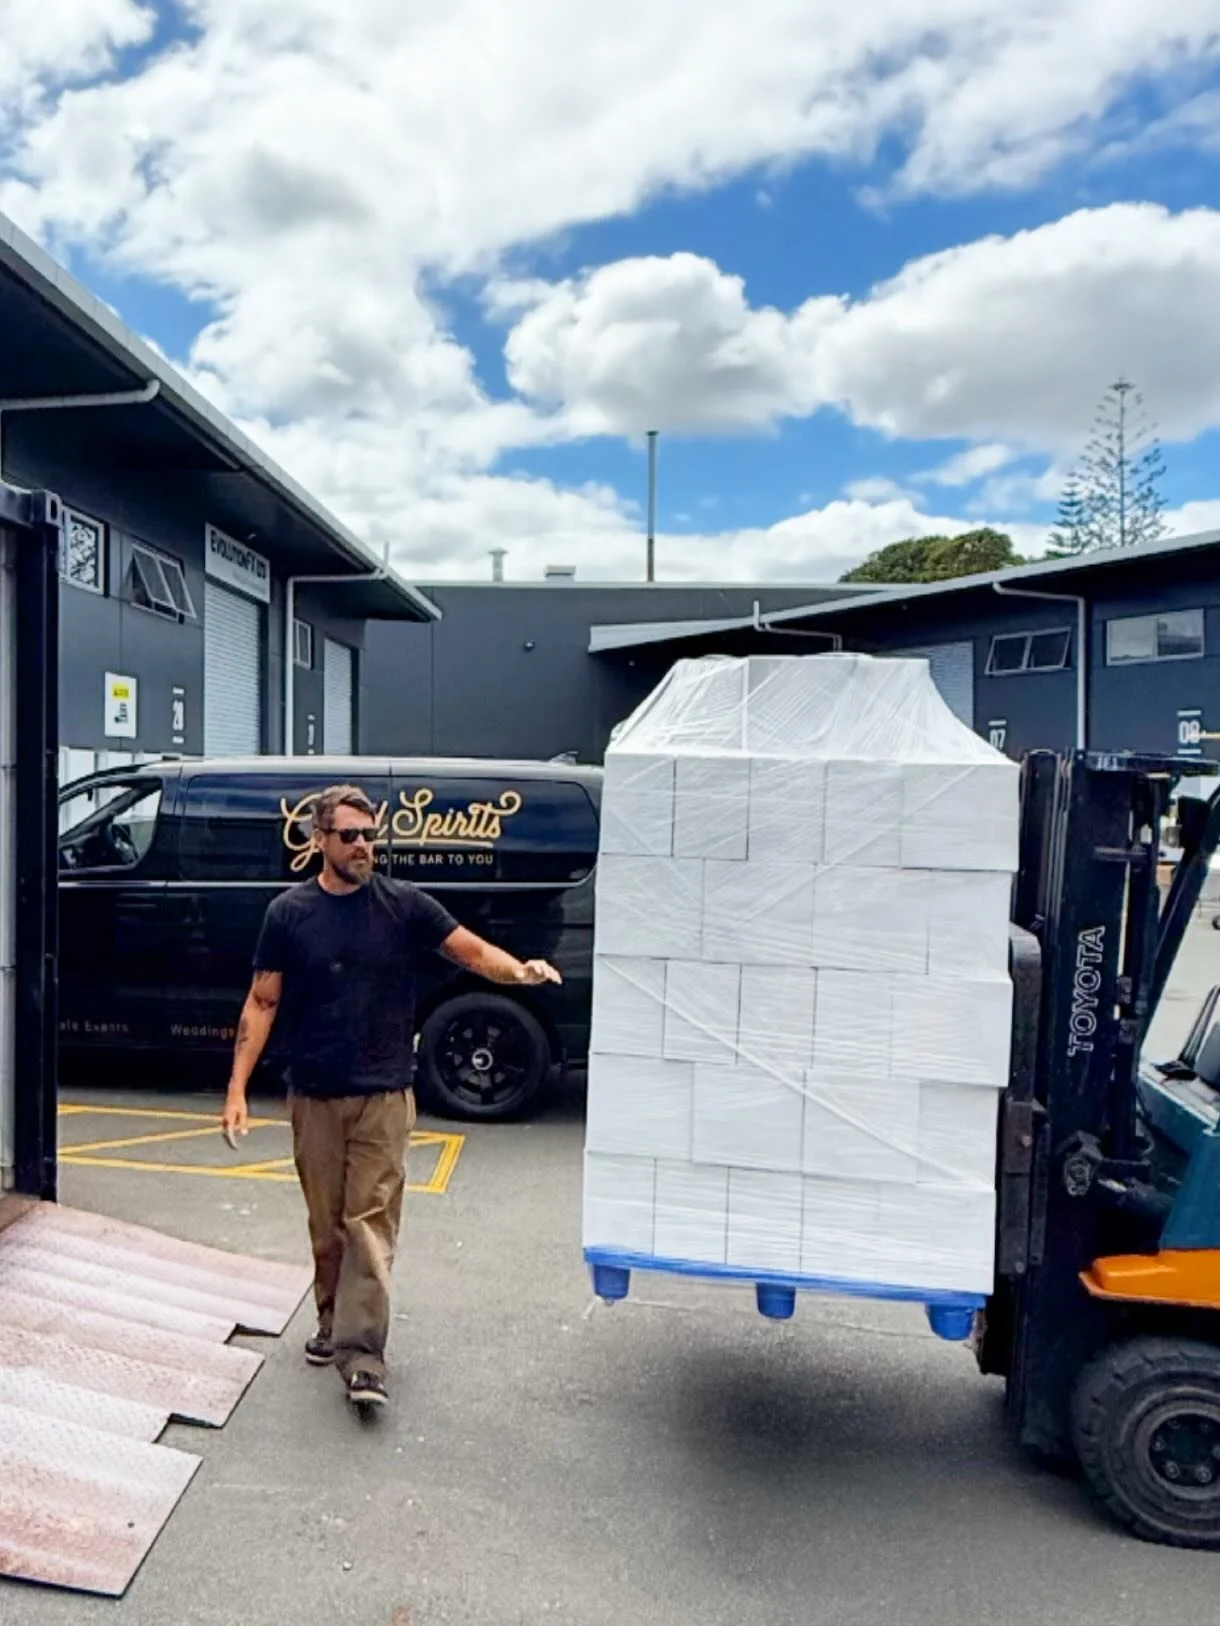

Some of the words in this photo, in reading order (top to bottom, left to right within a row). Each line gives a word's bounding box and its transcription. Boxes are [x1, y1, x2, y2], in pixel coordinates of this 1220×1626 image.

[989, 728, 1007, 751] 07
[1178, 719, 1201, 745] 08
[392, 788, 521, 846] Spirits
[391, 853, 415, 866] THE
[420, 853, 443, 866] BAR
[447, 853, 464, 866] TO
[468, 853, 494, 866] YOU
[1066, 925, 1105, 1057] TOYOTA
[170, 1024, 235, 1041] Weddings
